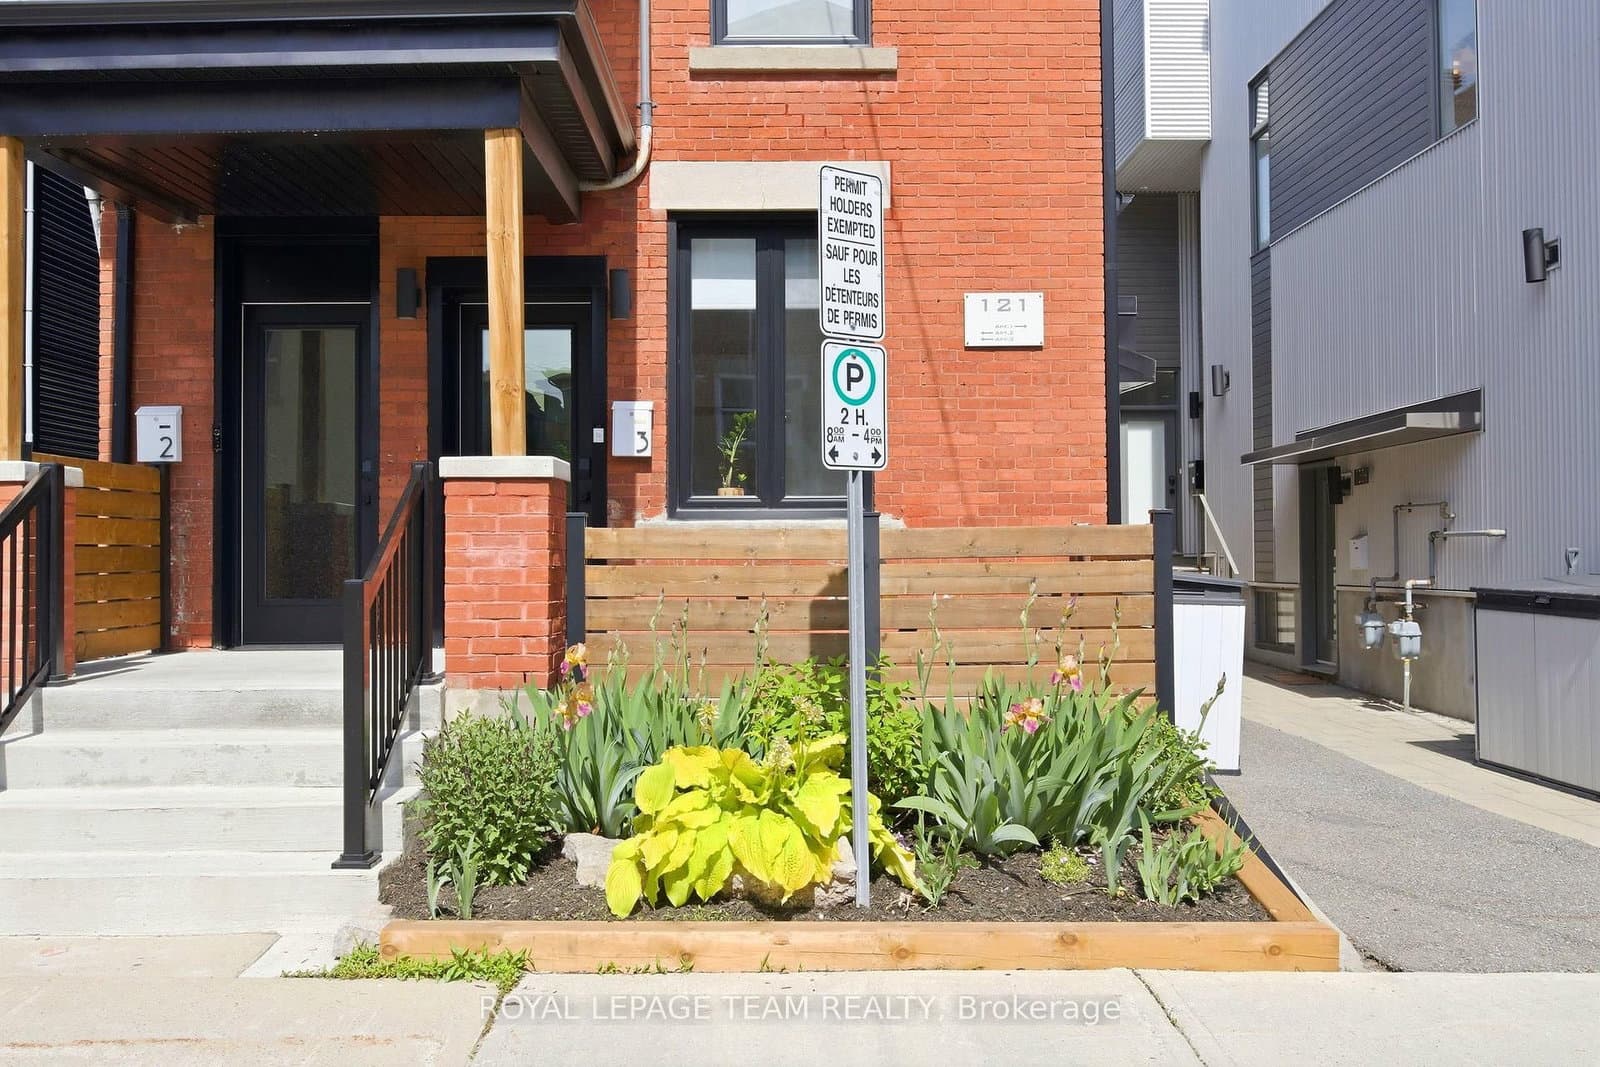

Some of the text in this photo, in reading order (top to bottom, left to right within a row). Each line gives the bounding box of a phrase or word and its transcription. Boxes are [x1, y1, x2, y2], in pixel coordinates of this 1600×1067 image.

[834, 175, 867, 196] PERMIT
[830, 195, 872, 218] HOLDERS
[827, 216, 875, 239] EXEMPTED
[826, 243, 878, 266] SAUF POUR
[843, 267, 861, 285] LES
[825, 283, 879, 309] DÉTENTEURS
[981, 298, 1025, 312] 121
[827, 307, 878, 329] DE PERMIS
[846, 362, 864, 391] P
[840, 407, 869, 426] 2 H.
[159, 436, 174, 458] 2
[636, 431, 649, 454] 3
